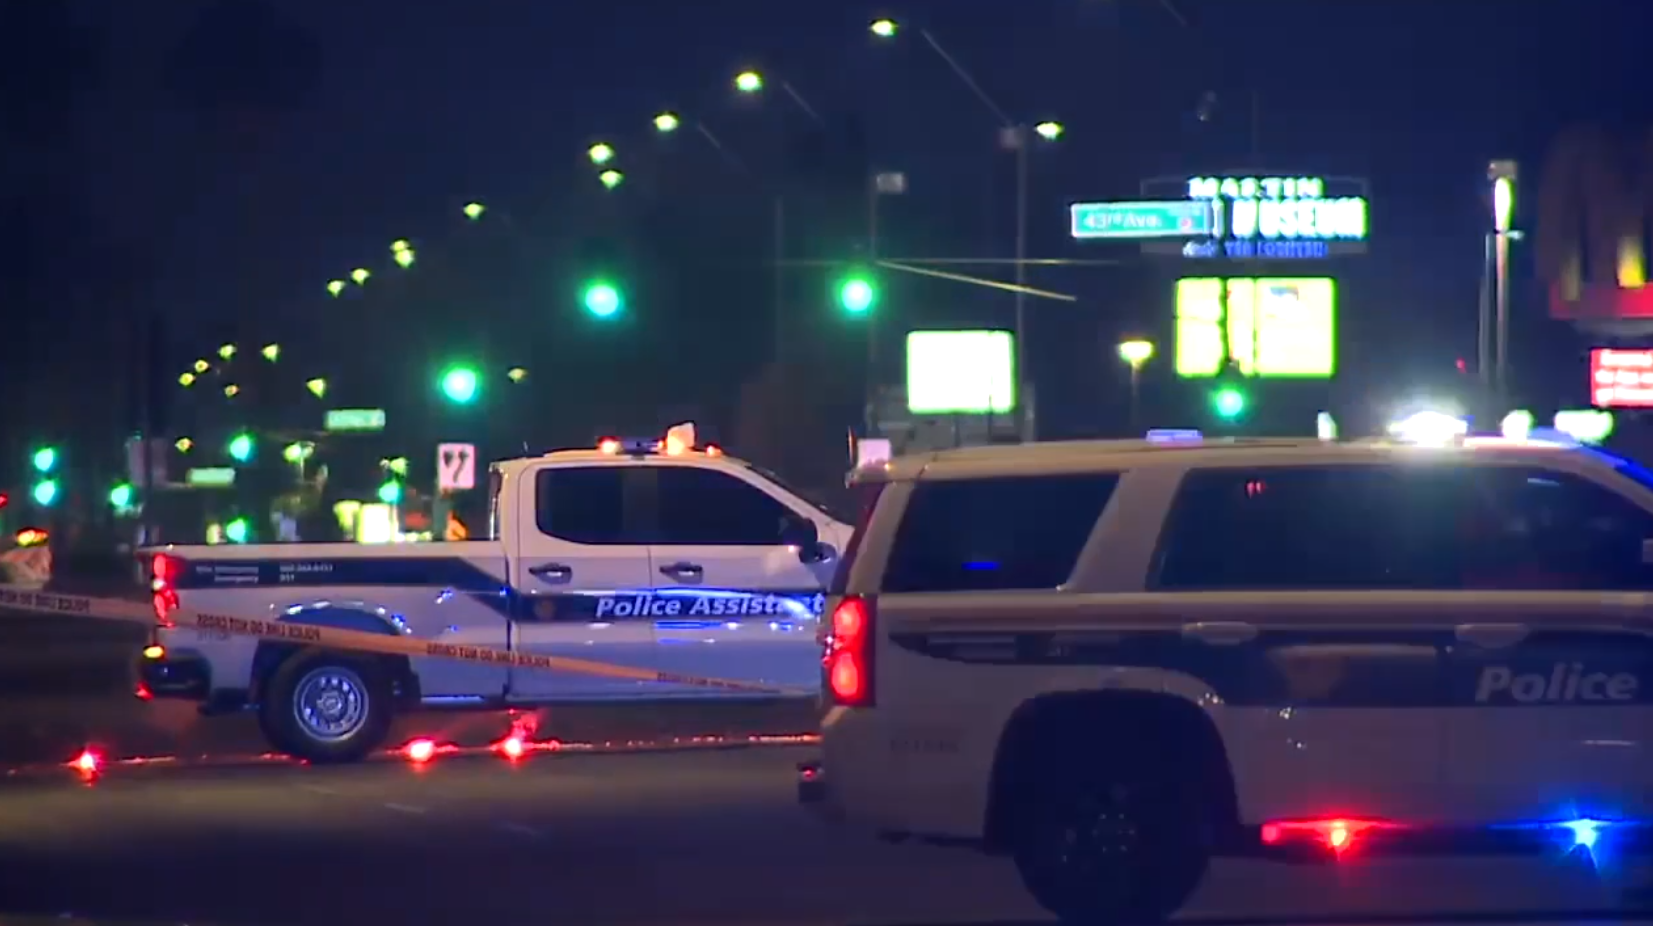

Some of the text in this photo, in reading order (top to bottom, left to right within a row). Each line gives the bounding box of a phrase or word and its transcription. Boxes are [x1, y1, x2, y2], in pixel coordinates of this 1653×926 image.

[1187, 176, 1323, 198] MARTIN
[1083, 211, 1122, 230] 43rd
[595, 593, 682, 618] Police
[1475, 661, 1639, 704] Police
